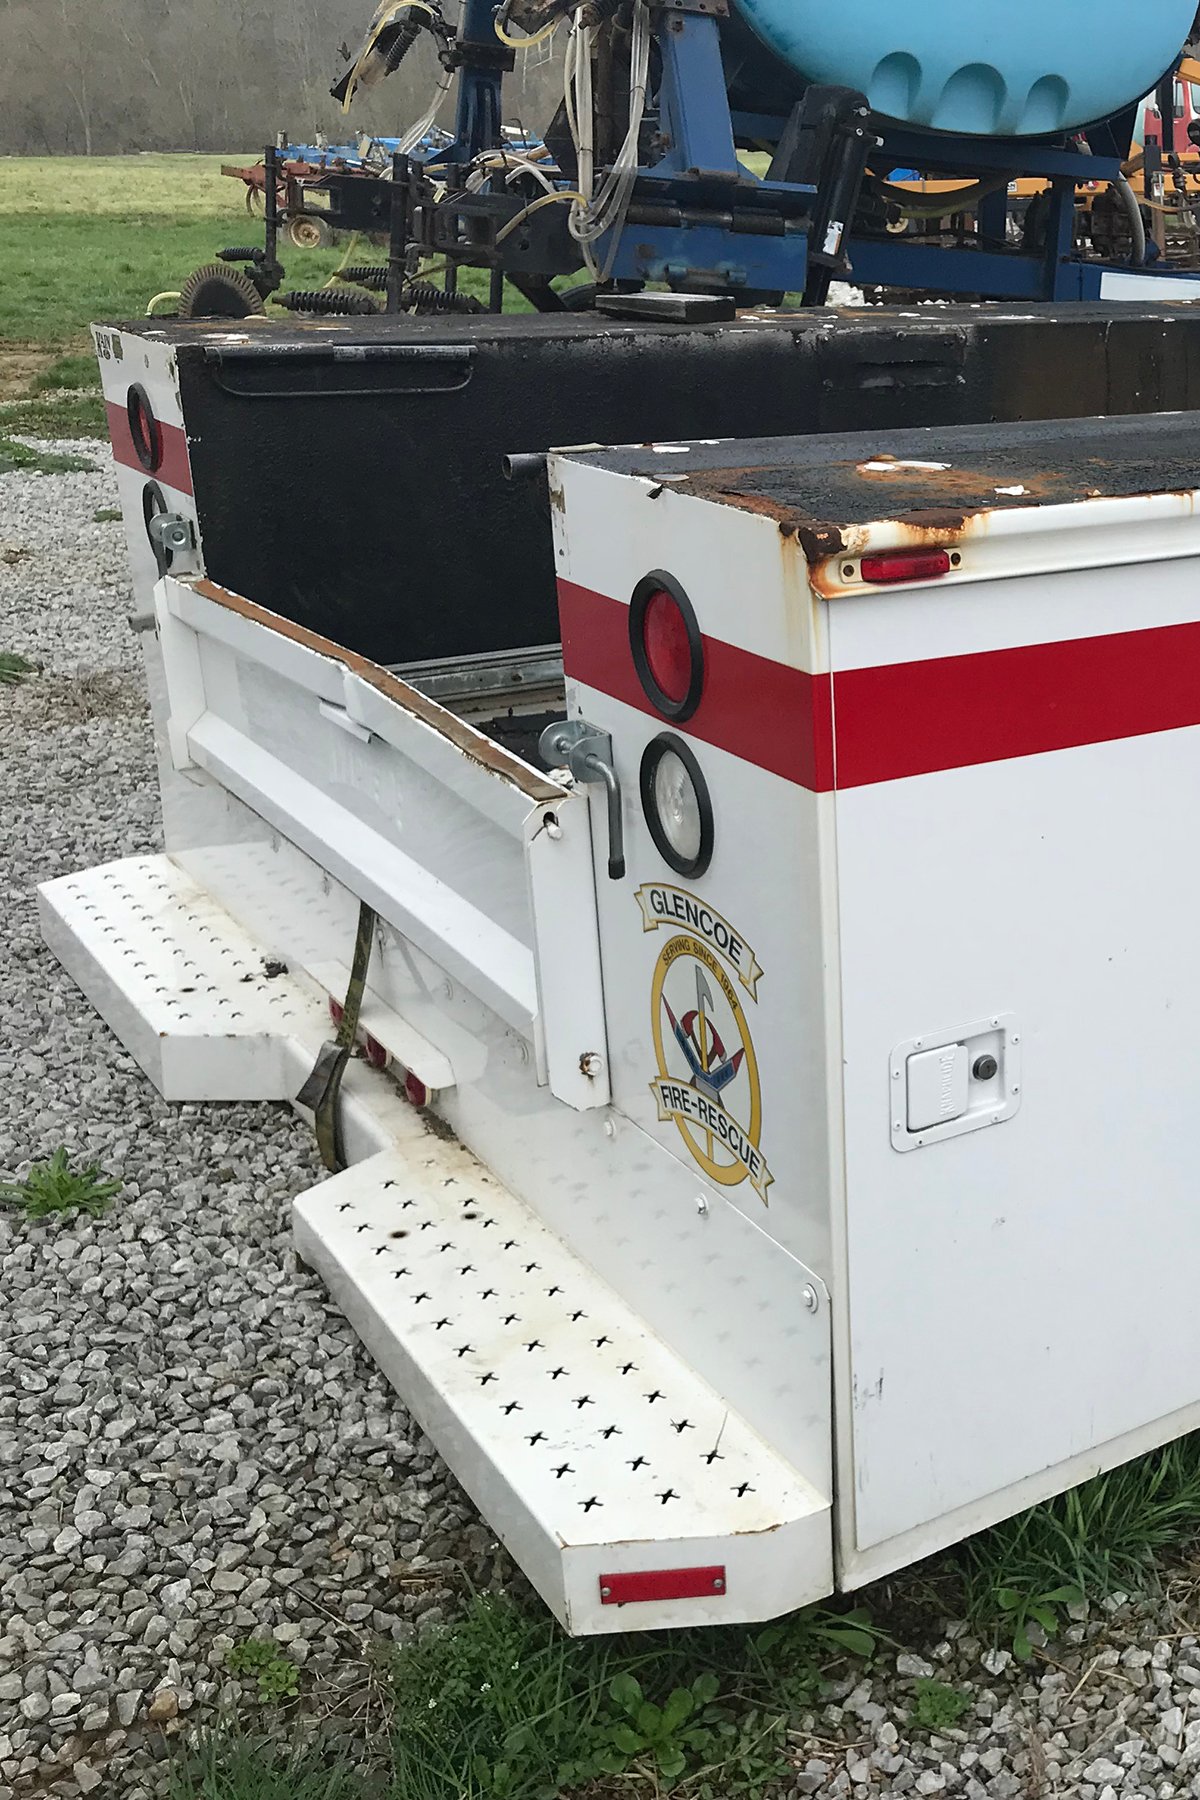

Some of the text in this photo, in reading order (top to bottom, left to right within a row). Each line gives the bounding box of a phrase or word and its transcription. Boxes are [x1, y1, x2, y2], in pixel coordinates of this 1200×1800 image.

[650, 888, 744, 965] GLENCOE
[662, 938, 691, 966] SERVING
[693, 944, 719, 976] SINCE
[660, 1084, 760, 1179] FIRE-RESCUE
